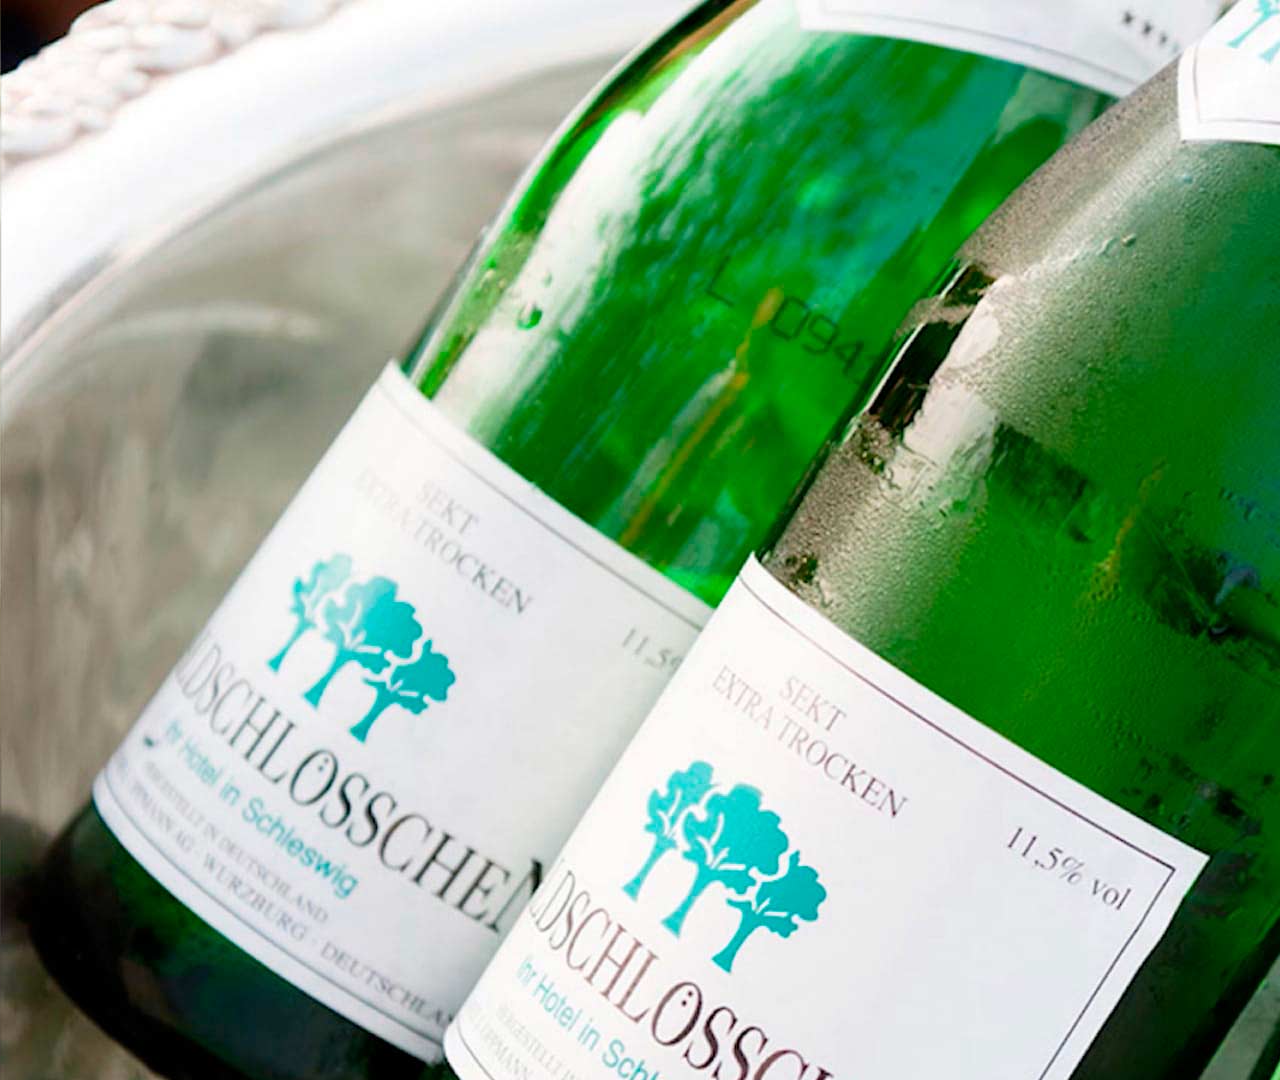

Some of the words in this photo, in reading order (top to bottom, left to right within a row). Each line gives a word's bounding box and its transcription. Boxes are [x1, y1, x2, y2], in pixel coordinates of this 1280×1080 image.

[419, 479, 480, 535] SEKT
[412, 518, 533, 615] TROCKEN
[712, 664, 775, 732] EXTRA
[776, 715, 909, 819] TROCKEN
[779, 675, 848, 732] SEKT
[220, 778, 241, 806] in
[241, 796, 359, 899] Schleswig
[1008, 827, 1086, 886] 11,5%
[1091, 878, 1132, 911] vol
[533, 972, 583, 1031] Hotel
[578, 1017, 601, 1051] in
